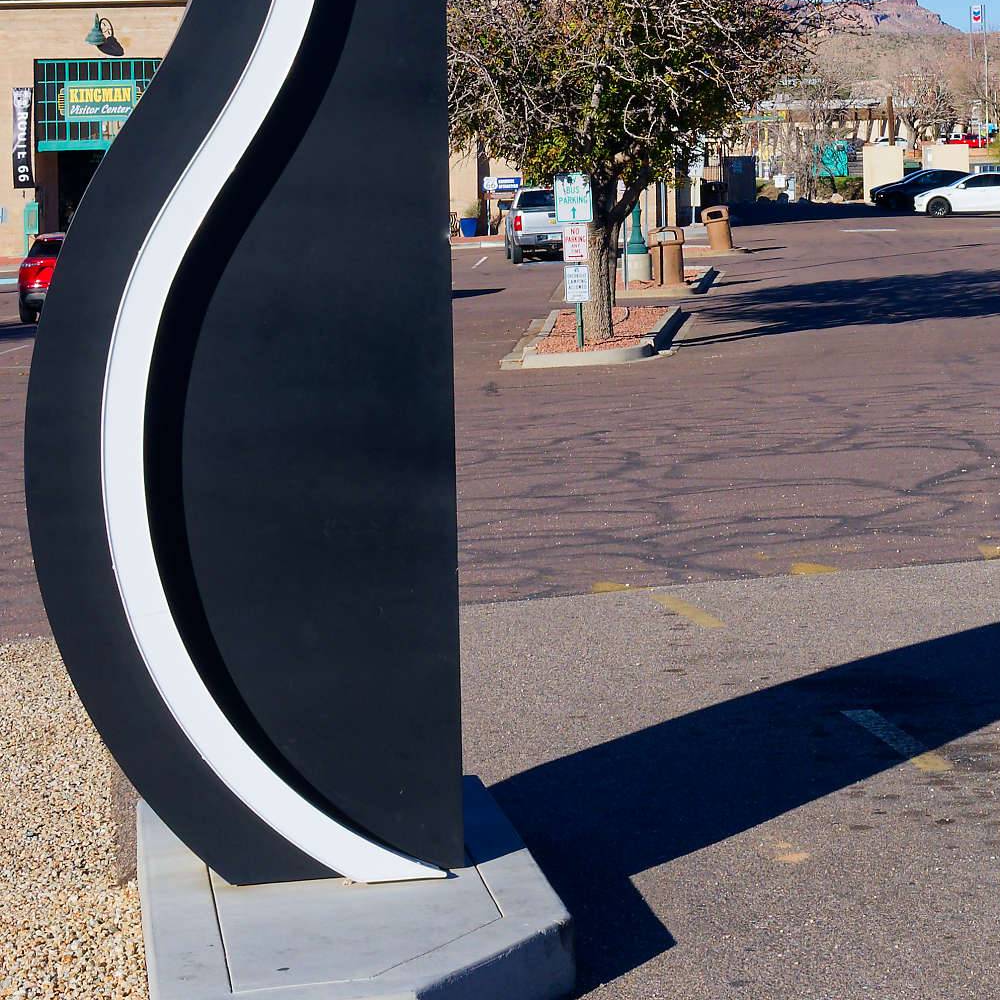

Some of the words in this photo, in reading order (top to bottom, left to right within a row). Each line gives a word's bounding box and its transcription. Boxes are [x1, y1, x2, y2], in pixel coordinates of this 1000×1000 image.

[69, 87, 131, 103] KINGMAN
[69, 104, 99, 115] Visitor
[101, 104, 132, 114] Center
[17, 111, 29, 160] ROUTE
[17, 165, 29, 182] 66
[566, 186, 579, 194] BUS
[559, 195, 588, 204] PARKING
